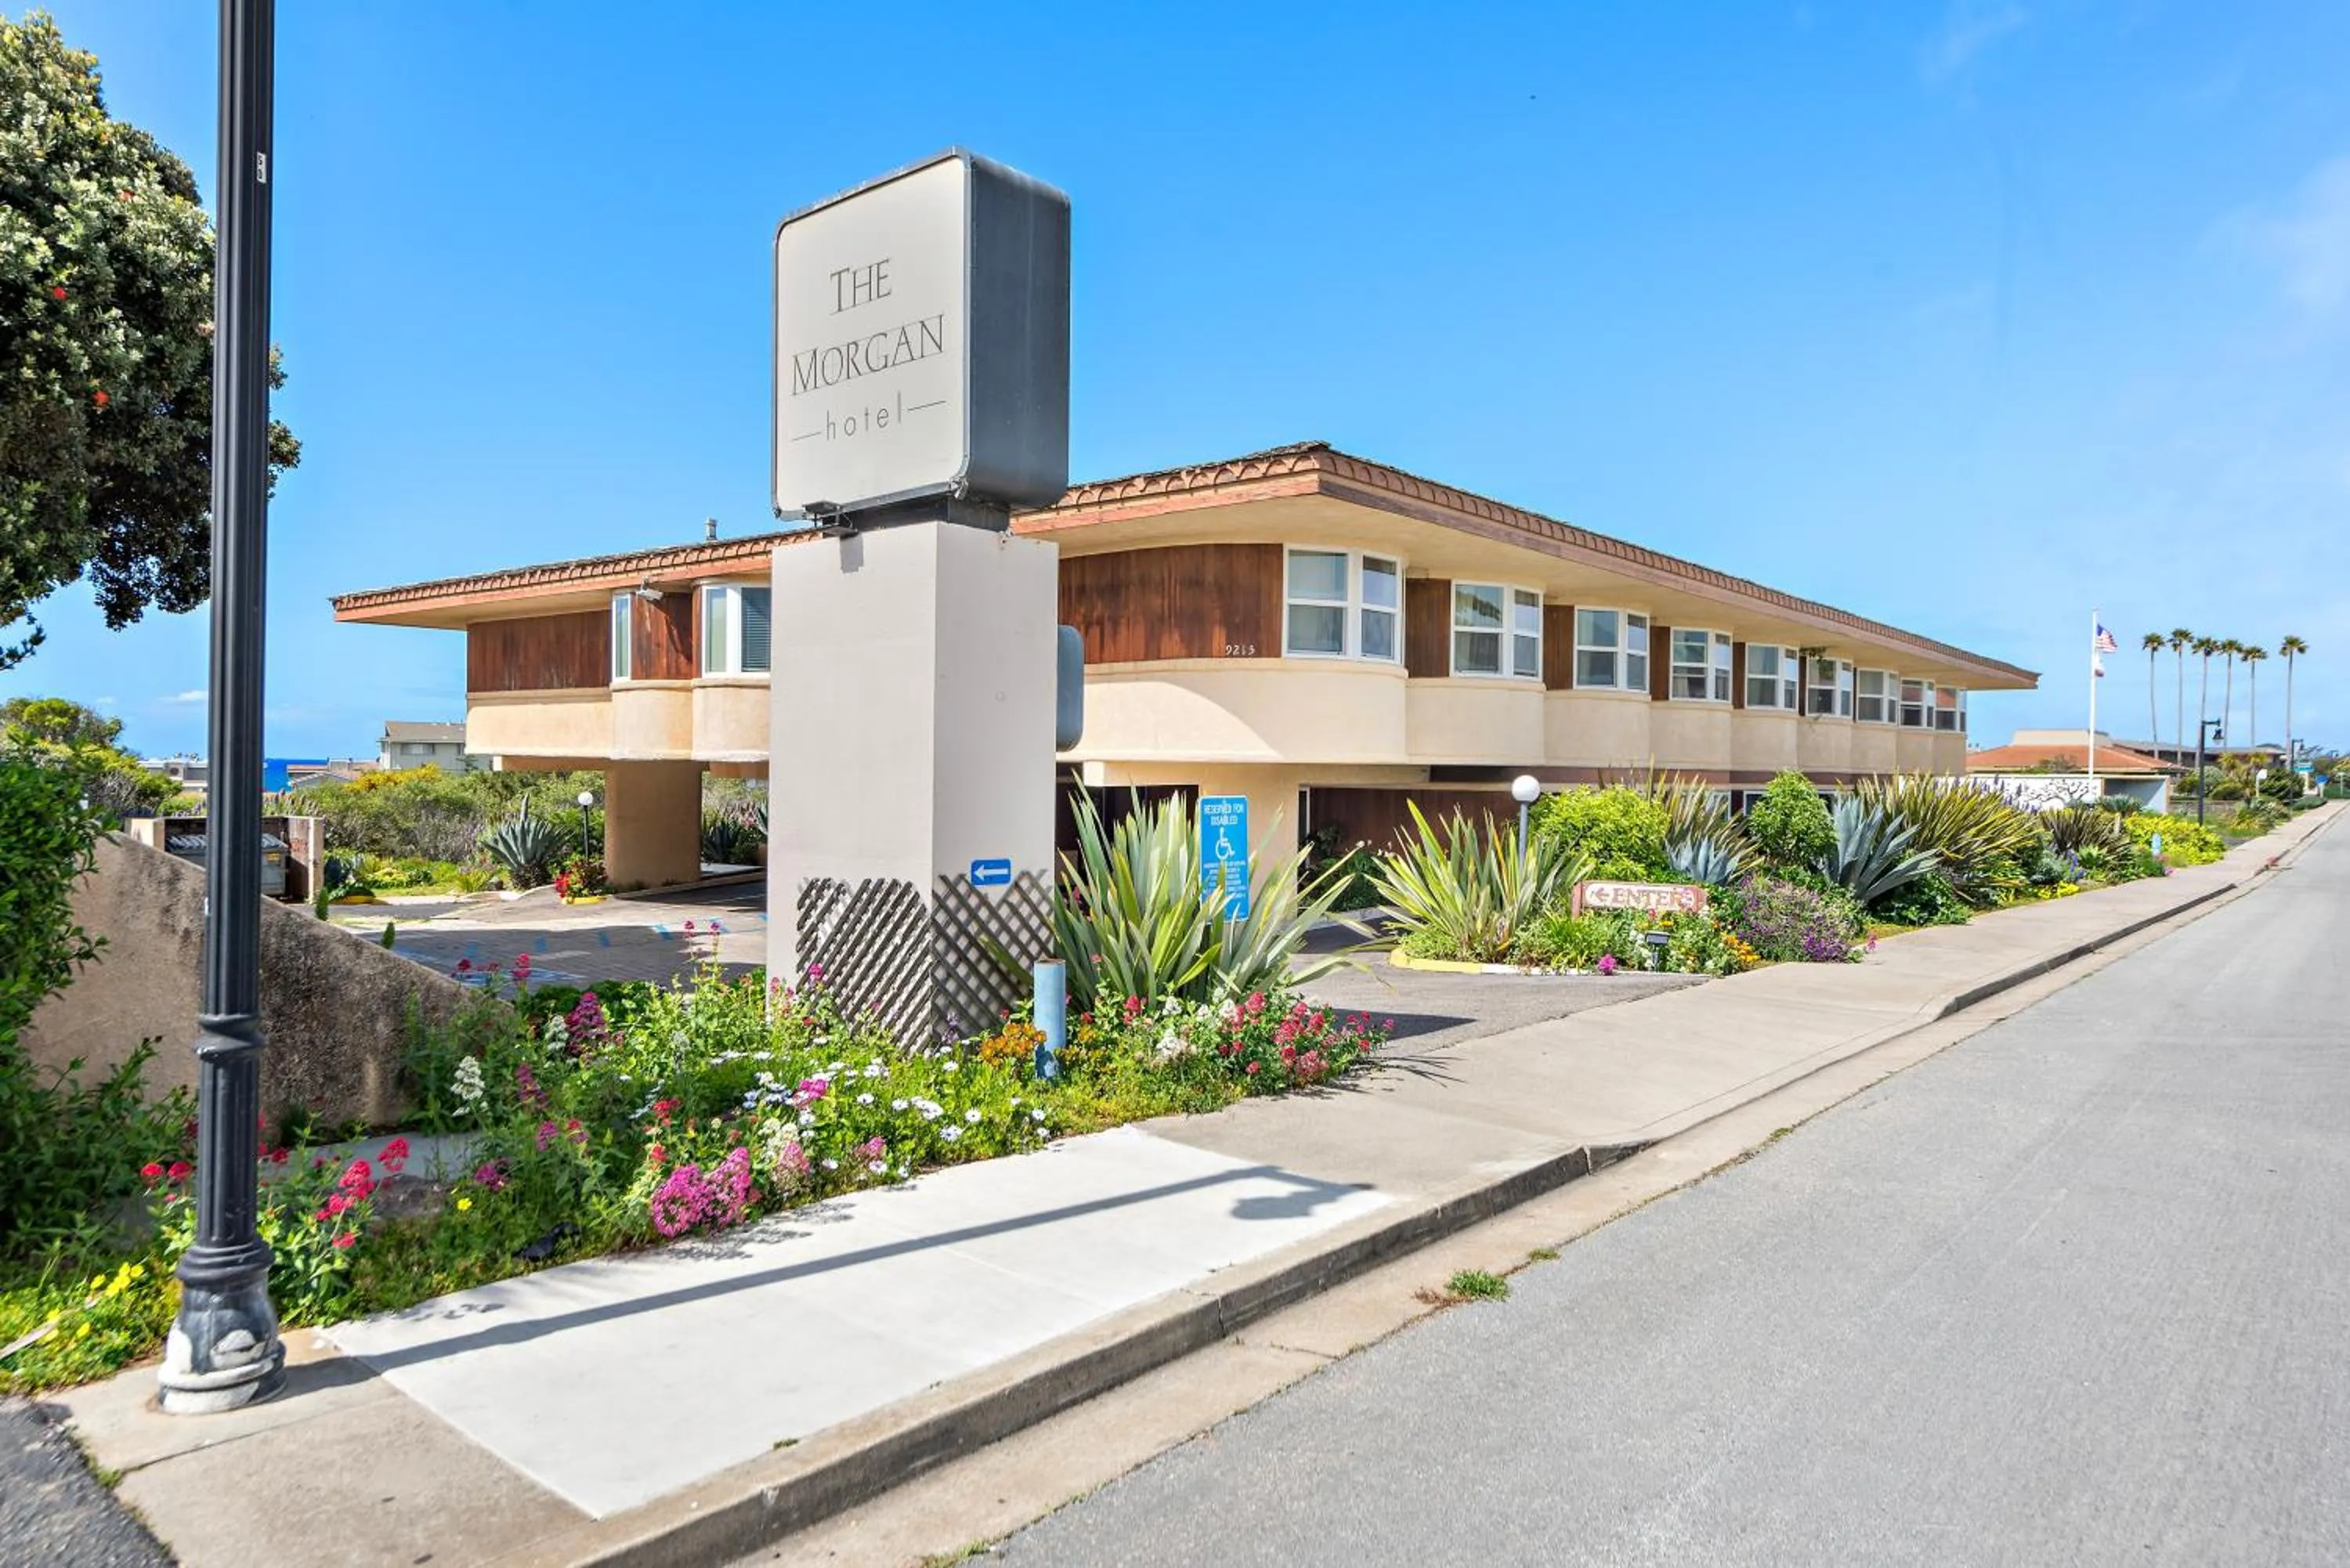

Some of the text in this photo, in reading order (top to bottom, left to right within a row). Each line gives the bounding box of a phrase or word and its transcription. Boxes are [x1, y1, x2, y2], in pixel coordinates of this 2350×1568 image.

[829, 258, 891, 313] THE
[790, 313, 945, 396] MORGAN
[826, 390, 902, 441] hotel
[1226, 645, 1256, 656] 9215
